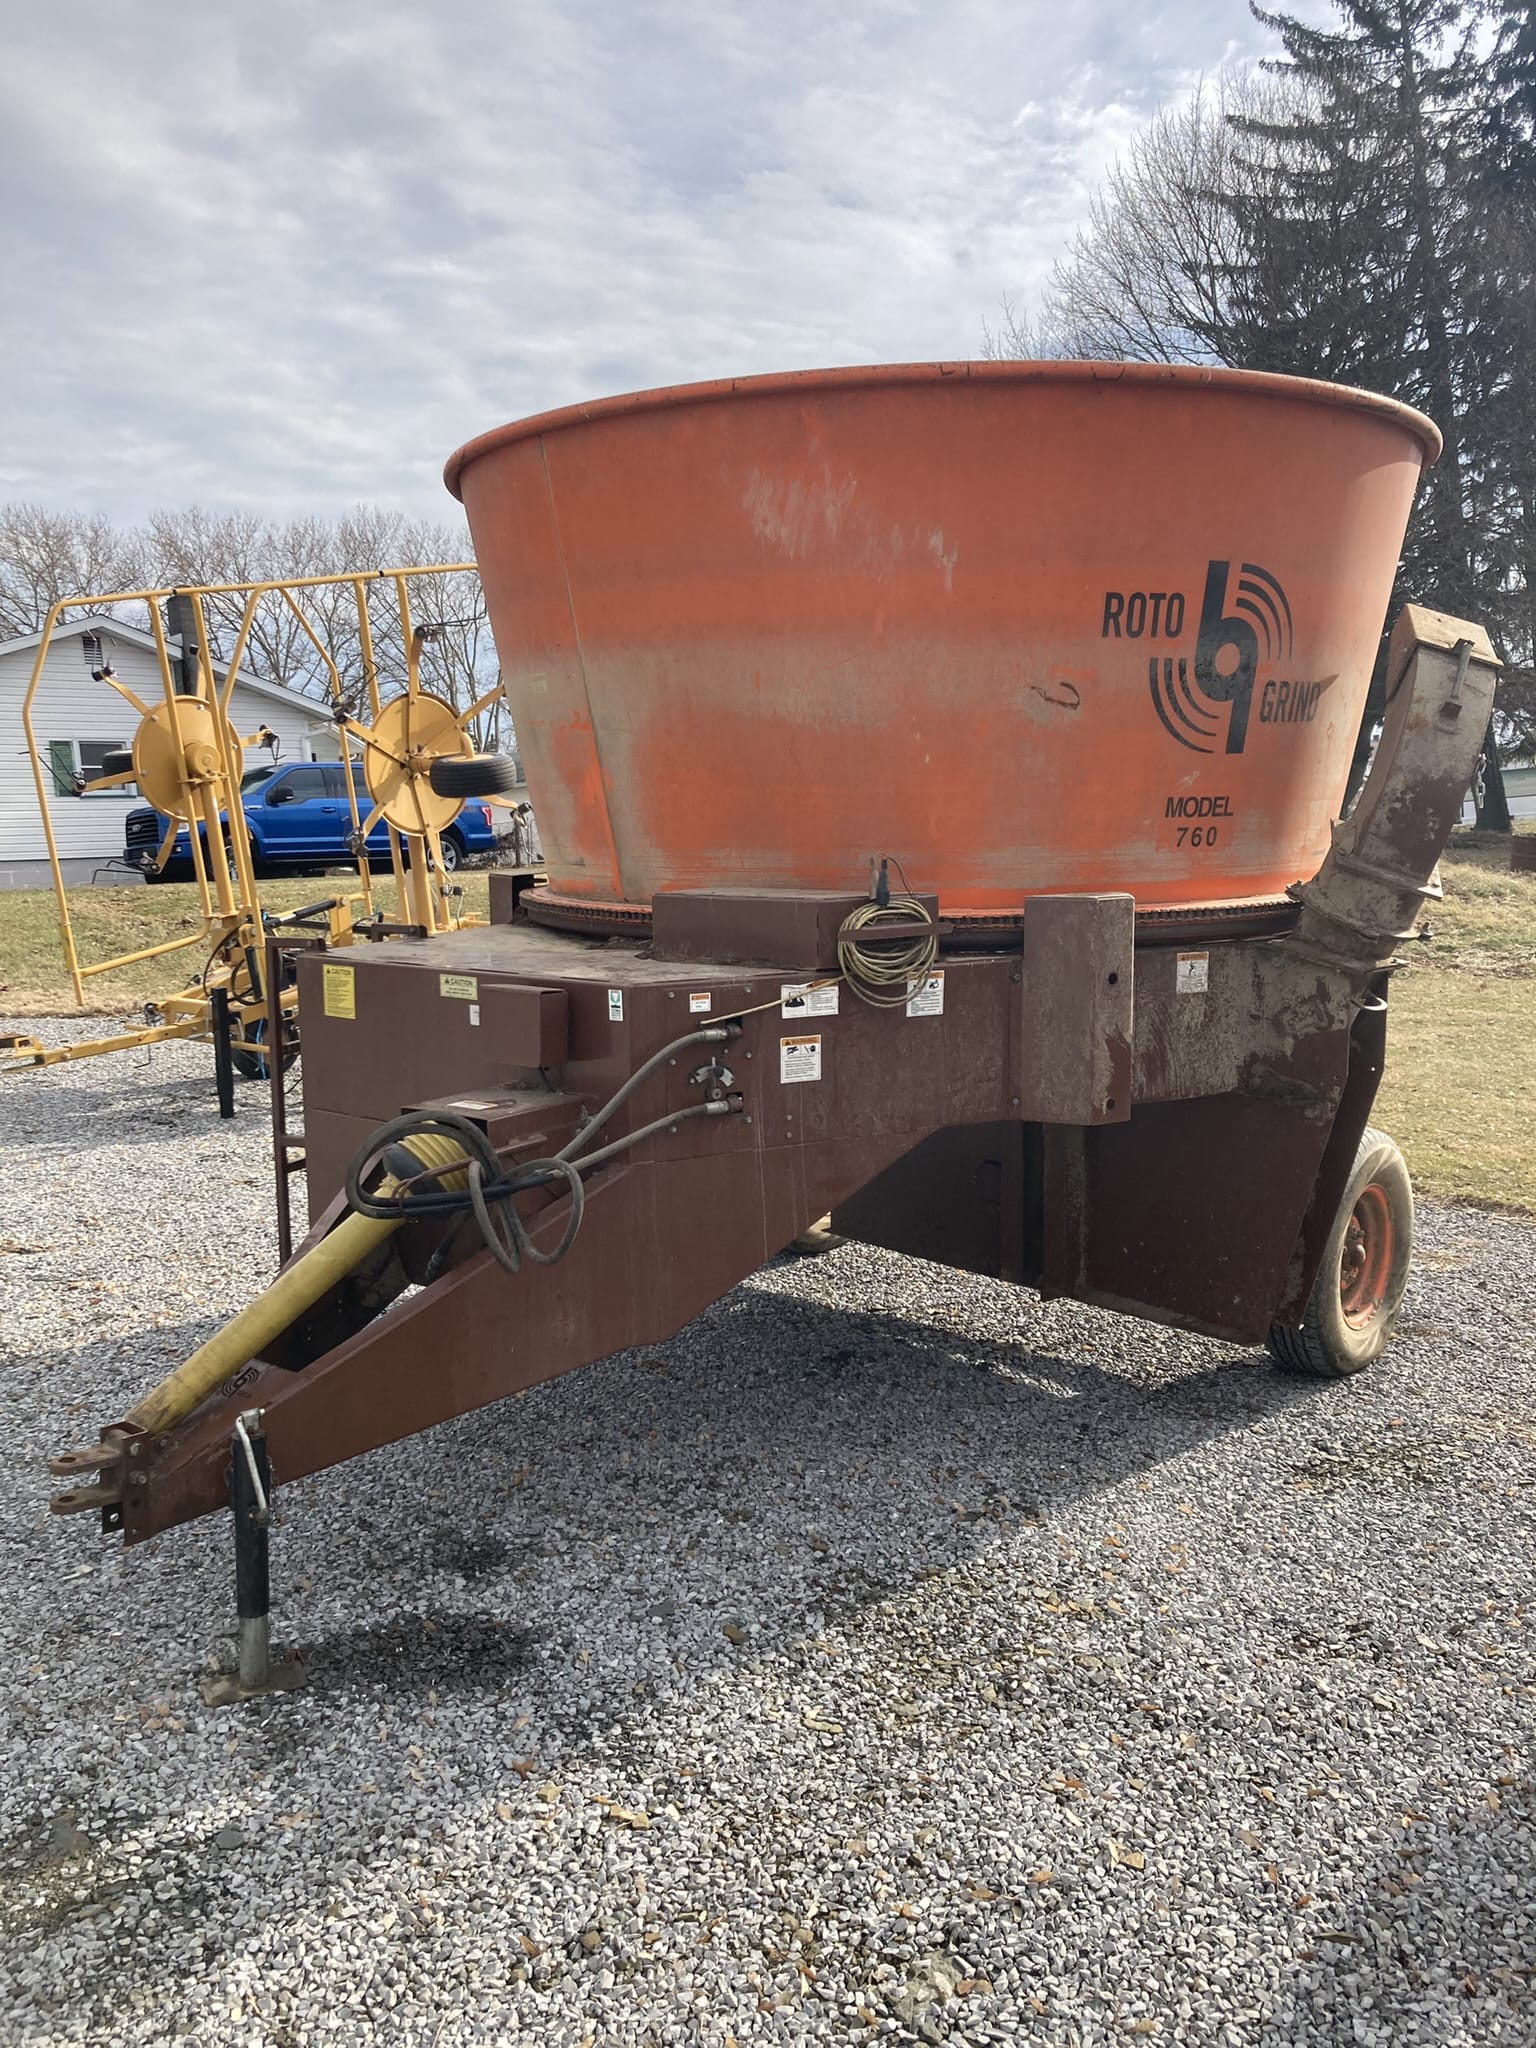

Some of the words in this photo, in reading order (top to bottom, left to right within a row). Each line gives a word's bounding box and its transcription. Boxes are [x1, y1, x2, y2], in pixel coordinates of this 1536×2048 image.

[1102, 592, 1185, 638] ROTO
[1260, 680, 1321, 722] GRIND
[1164, 796, 1233, 818] MODEL
[1176, 826, 1217, 847] 760
